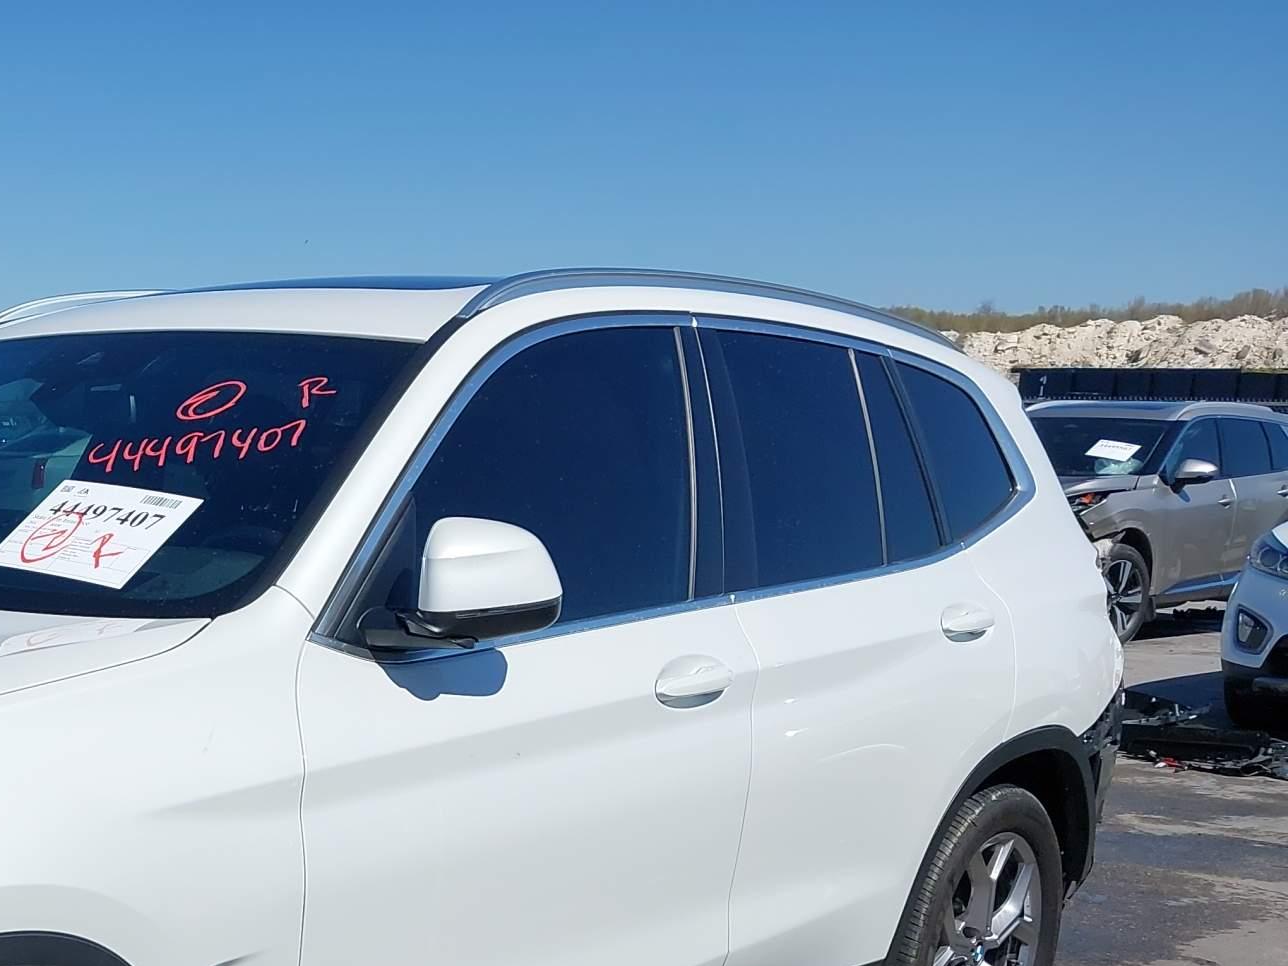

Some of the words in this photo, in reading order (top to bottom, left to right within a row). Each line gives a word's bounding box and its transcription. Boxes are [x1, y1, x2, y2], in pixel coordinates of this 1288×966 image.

[299, 377, 337, 408] R
[88, 419, 307, 472] 44497407
[49, 500, 167, 530] 44497407
